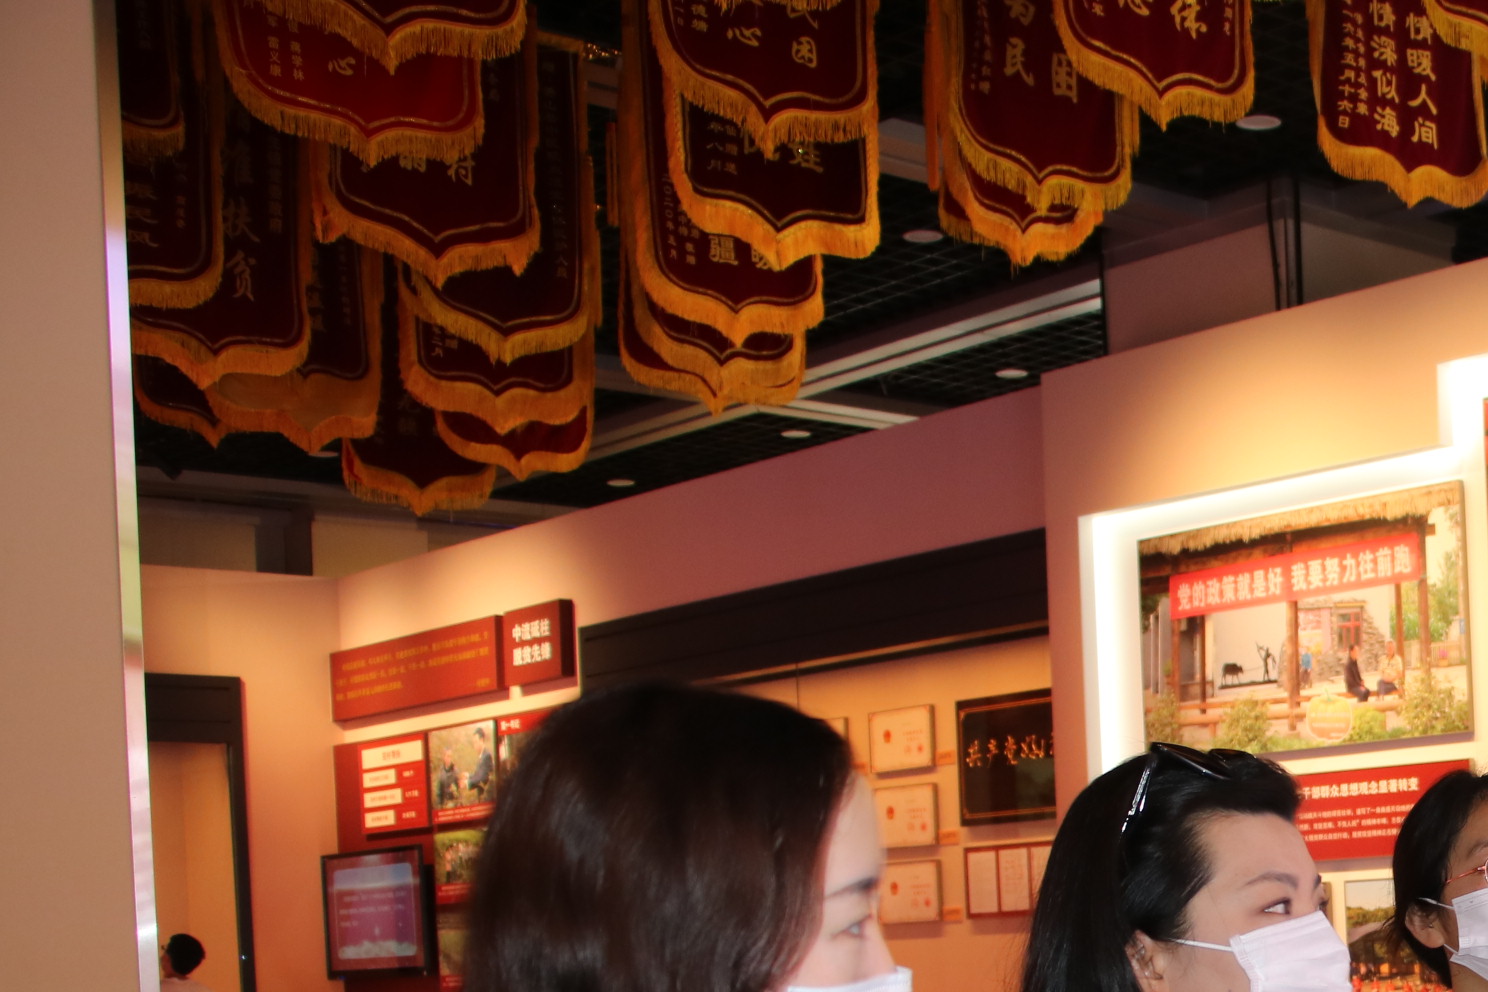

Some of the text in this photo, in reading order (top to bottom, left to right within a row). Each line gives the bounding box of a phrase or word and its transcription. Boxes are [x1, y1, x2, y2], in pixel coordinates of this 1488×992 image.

[1405, 11, 1438, 150] 情暖人间
[1177, 544, 1412, 611] 党的政策就是好 我要努力往前跑
[512, 618, 551, 643] 中流砥柱
[513, 642, 552, 667] 脱贫先锋
